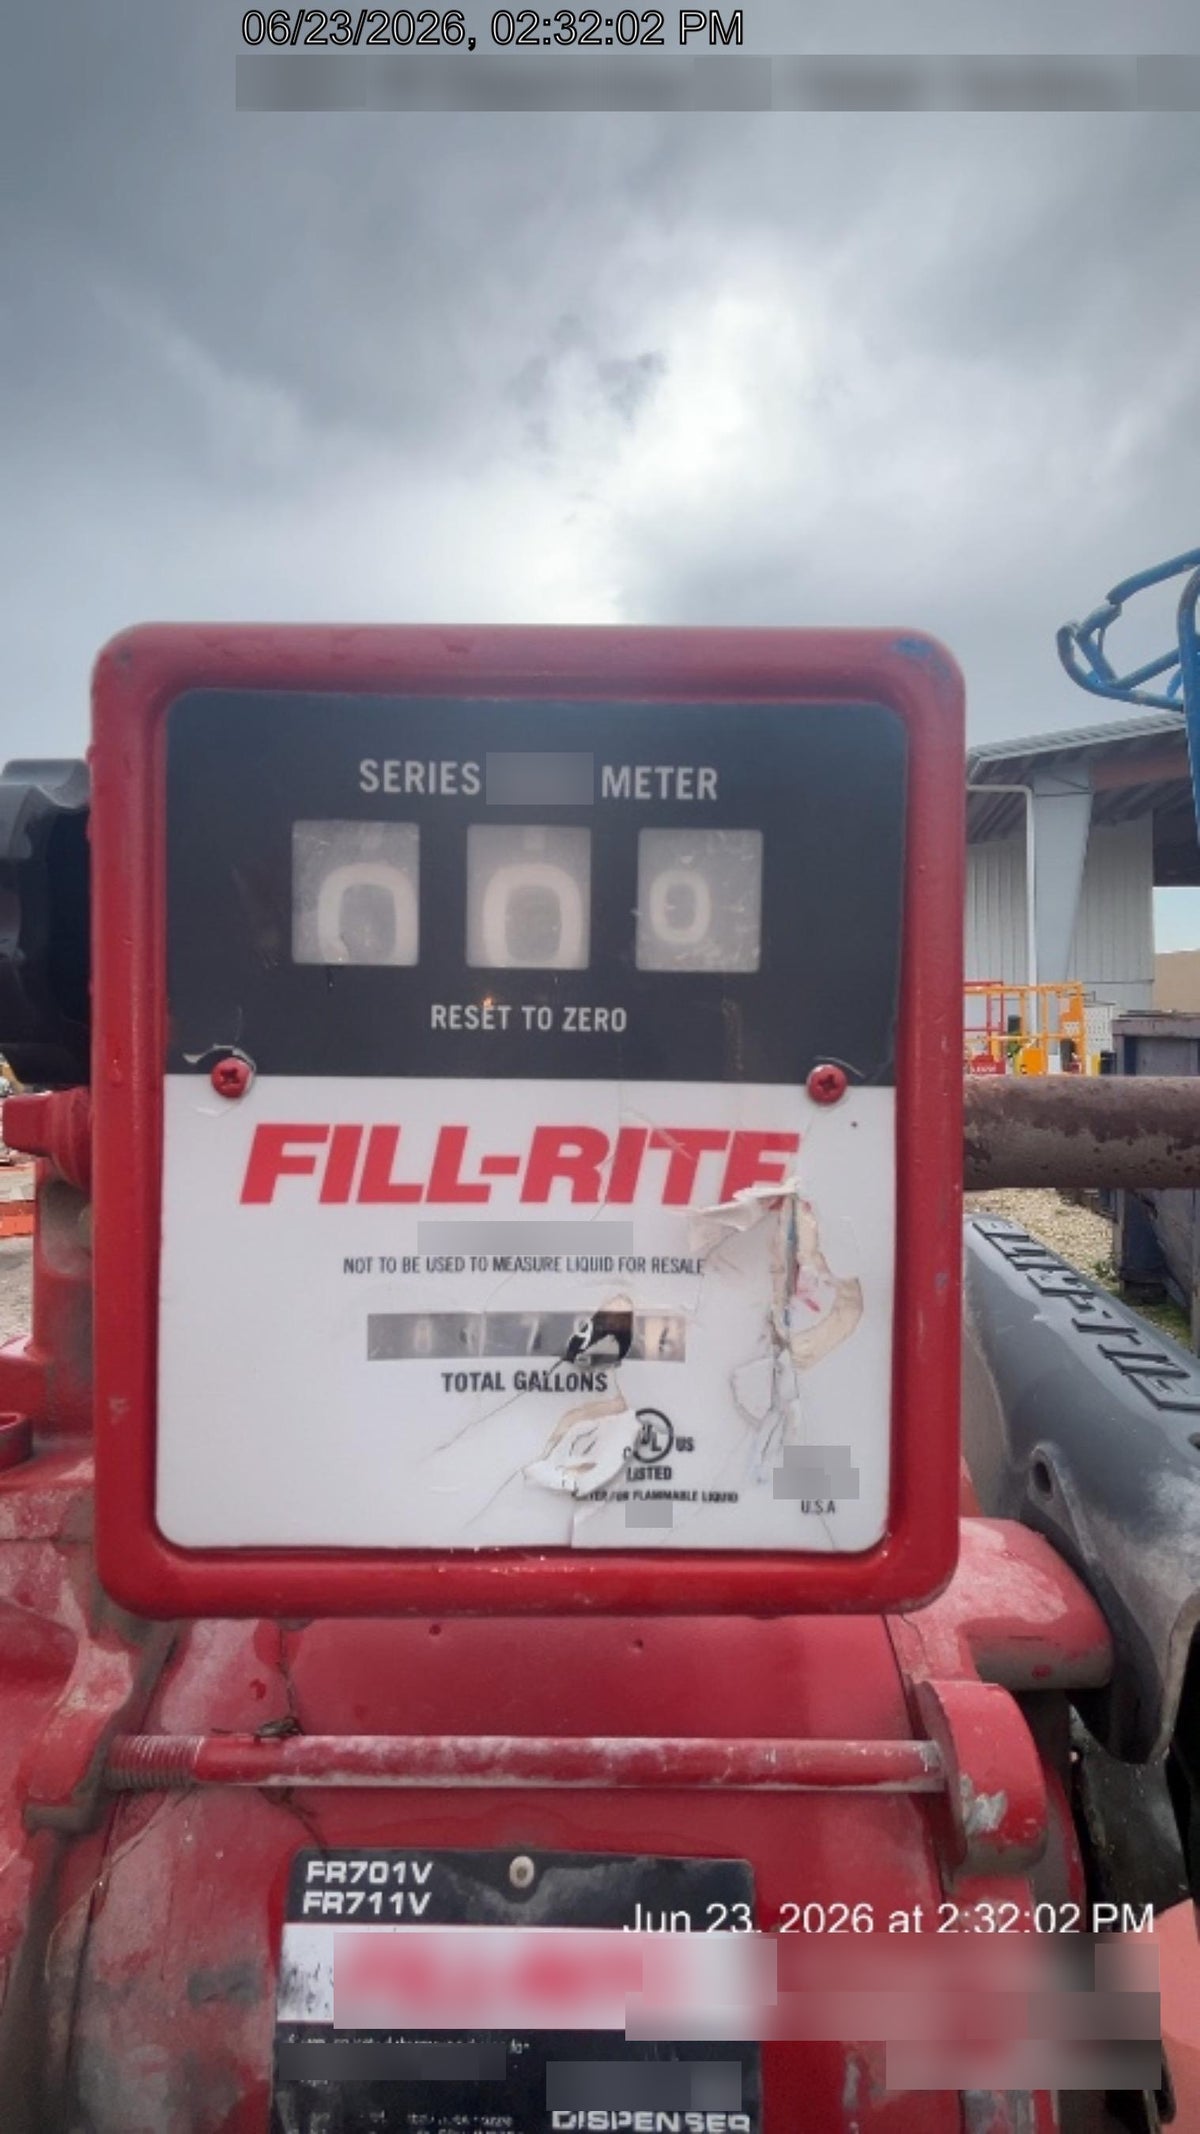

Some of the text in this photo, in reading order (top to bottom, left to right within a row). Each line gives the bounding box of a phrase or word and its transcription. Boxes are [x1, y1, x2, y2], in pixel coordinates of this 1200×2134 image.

[359, 759, 718, 800] SERIES METER
[649, 869, 711, 944] 0
[430, 1004, 627, 1032] RESET TO ZERO
[240, 1123, 800, 1205] FILL-RITE
[343, 1256, 705, 1275] NOT TO BE USED TO MEASURE LIQUID FOR RESALE
[441, 1371, 608, 1394] TOTAL GALLONS
[676, 1436, 694, 1452] US
[306, 1861, 433, 1884] FR701V
[302, 1891, 432, 1915] FR711V
[552, 2110, 751, 2134] DISPENSER
